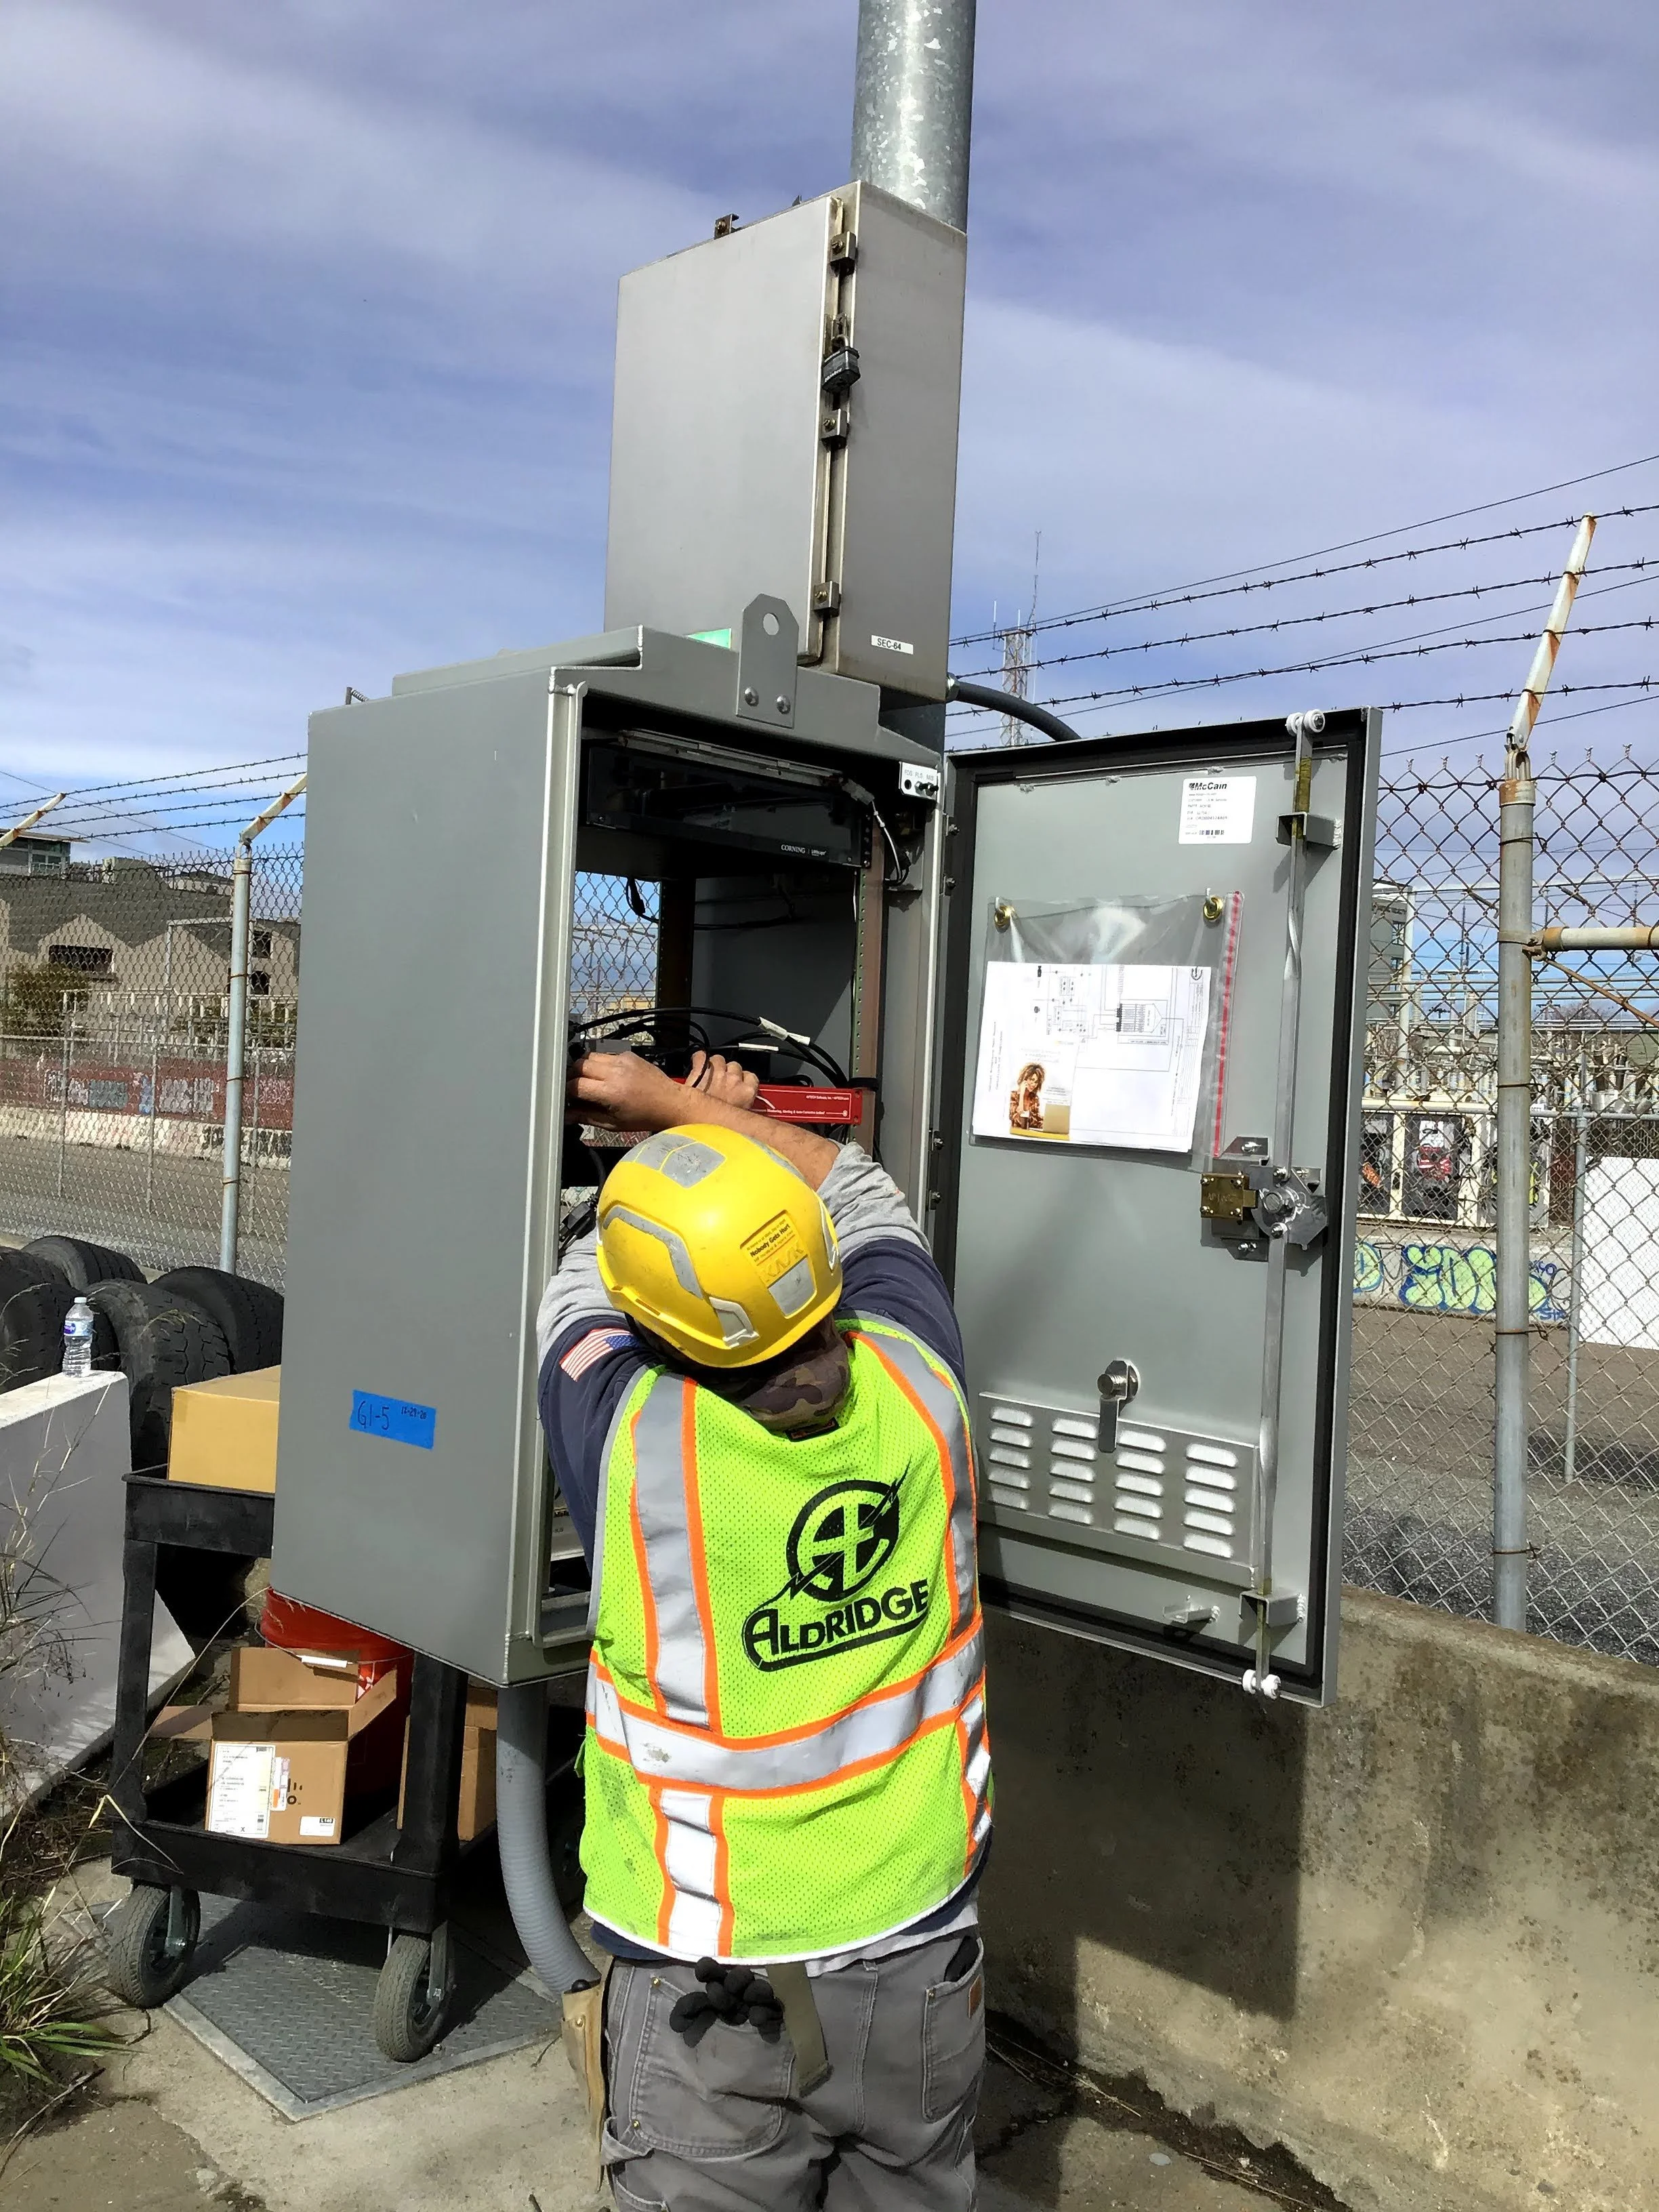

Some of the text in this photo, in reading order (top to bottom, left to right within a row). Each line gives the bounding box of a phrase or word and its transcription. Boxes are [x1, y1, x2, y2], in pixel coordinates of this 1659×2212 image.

[877, 638, 901, 651] SEC-64
[1195, 782, 1227, 790] McCain
[781, 844, 806, 854] CORNING
[750, 1223, 791, 1257] Nobody Gets Hurt
[743, 1578, 929, 1664] ALDRIDGE
